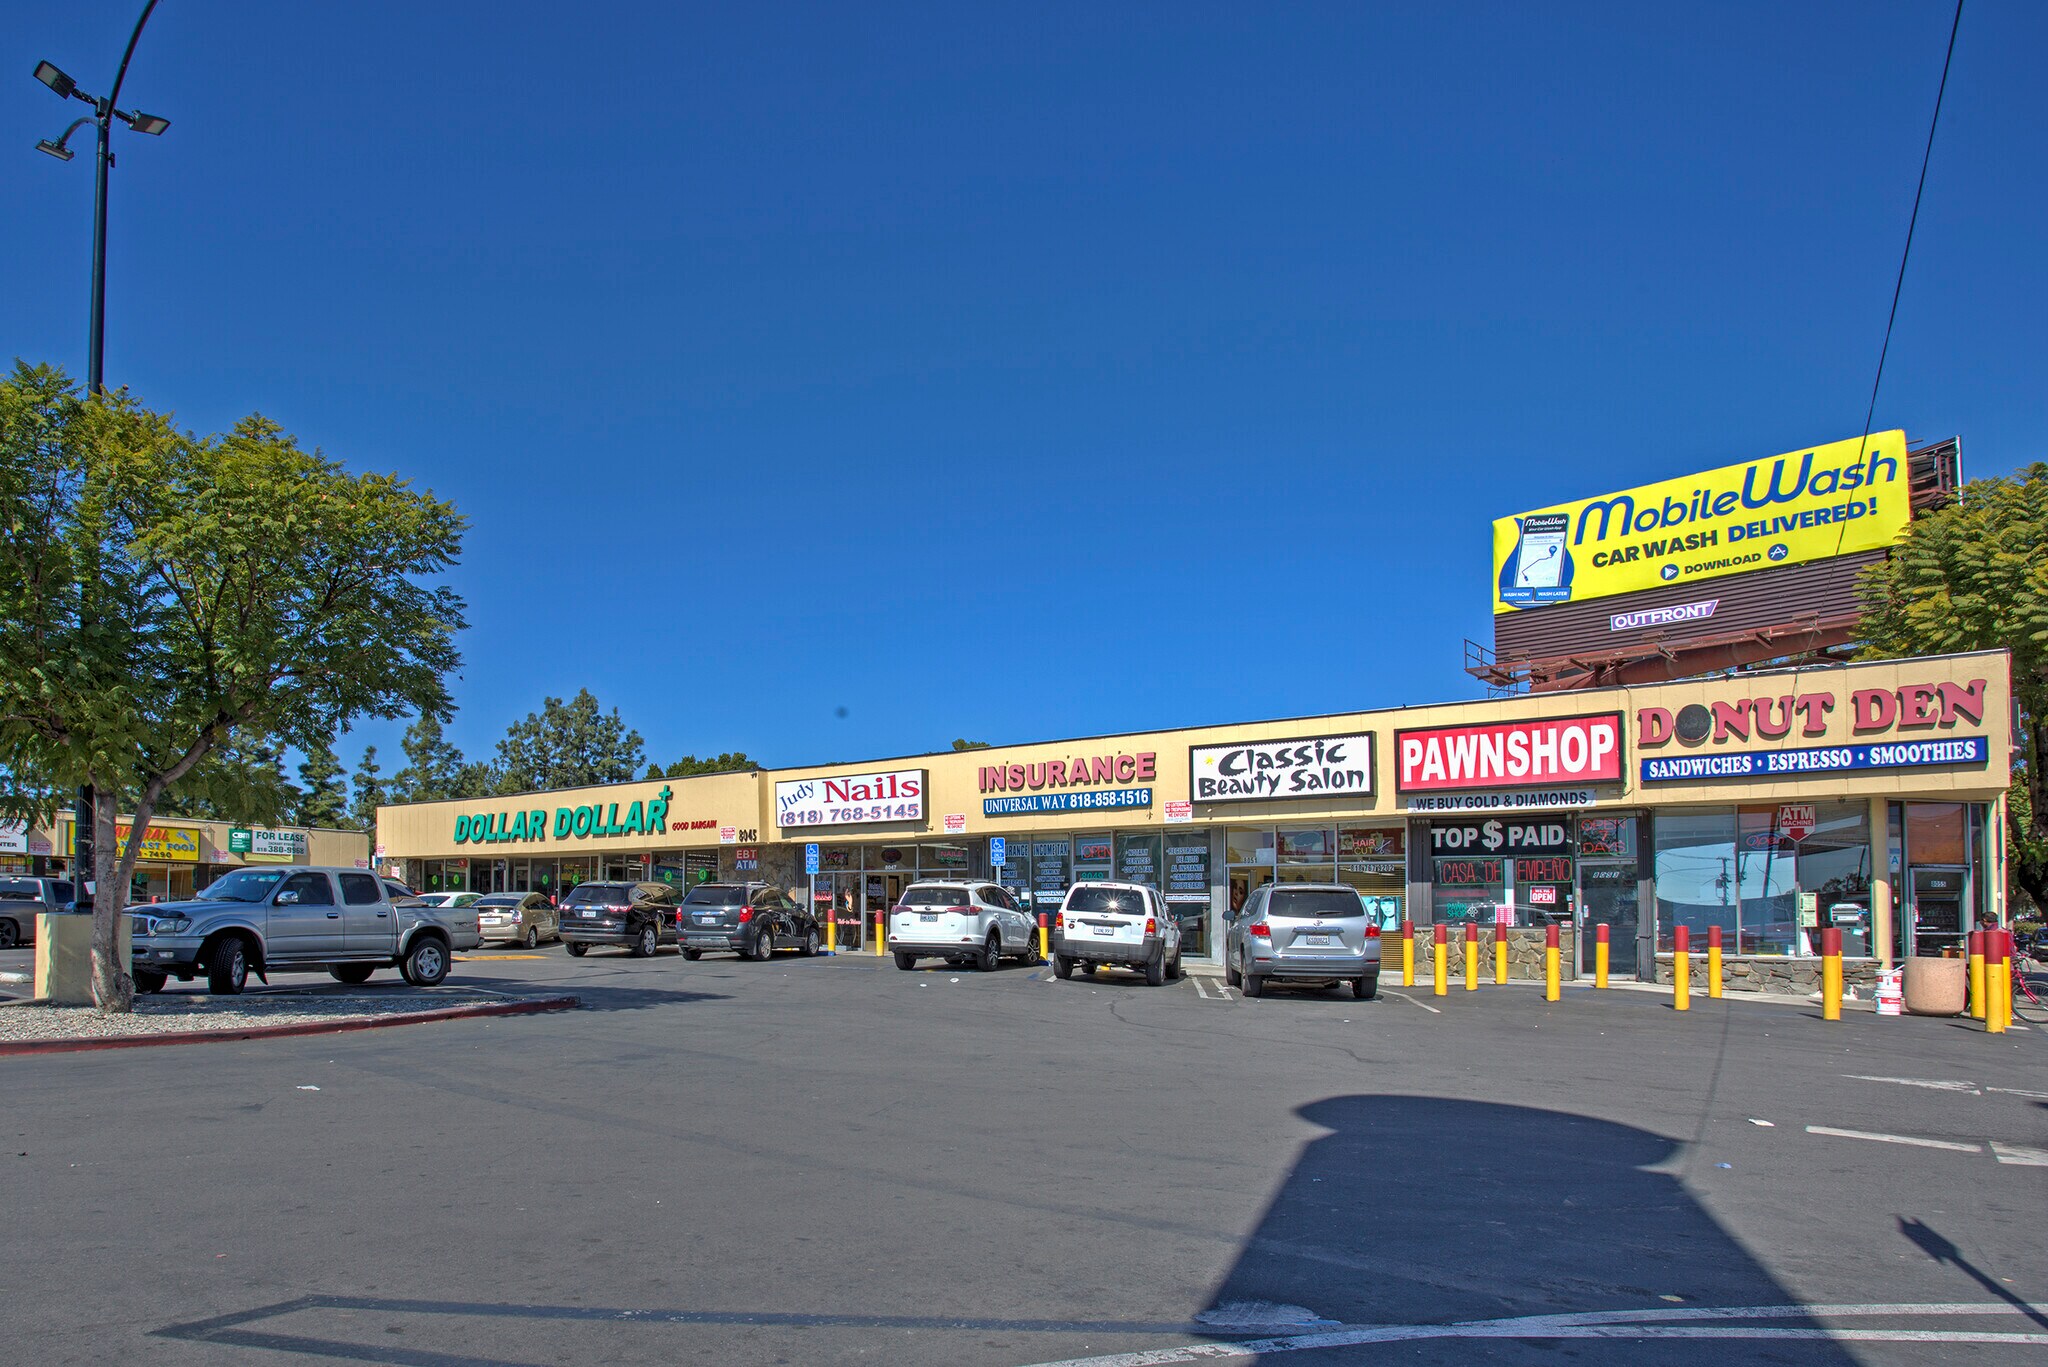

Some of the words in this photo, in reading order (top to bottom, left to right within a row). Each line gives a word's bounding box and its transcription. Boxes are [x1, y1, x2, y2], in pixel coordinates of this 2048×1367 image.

[1573, 451, 1898, 546] MobileWash
[1592, 544, 1640, 569] CAR
[1643, 530, 1718, 559] WASH
[1727, 497, 1878, 543] DELIVERED!
[1683, 552, 1762, 576] DOWNLOAD
[1614, 604, 1716, 630] OUTFRONT
[1852, 679, 1988, 733] DEN
[1218, 739, 1348, 777] Classic
[1402, 723, 1616, 783] PAWNSHOP
[1649, 755, 1752, 779] SANDWICHES
[1768, 748, 1852, 772] ESPRESSO
[1869, 741, 1977, 766] SMOOTHIES
[978, 752, 1157, 791] INSURANCE
[1198, 771, 1281, 798] Beauty
[1290, 769, 1365, 792] Salon
[778, 782, 815, 812] Judy
[823, 774, 920, 804] Nails
[985, 797, 1039, 814] UNIVERSAL
[1041, 795, 1068, 810] WAY
[1069, 788, 1149, 809] 818-858-1516
[1416, 797, 1435, 811] WE
[1436, 796, 1463, 810] BUY
[1464, 794, 1500, 809] GOLD
[1503, 794, 1513, 807] &
[1513, 792, 1588, 807] DIAMONDS
[779, 807, 824, 828] (818)
[829, 803, 919, 823] 768-5145
[1782, 805, 1814, 820] ATM
[453, 810, 547, 843] DOLLAR
[672, 822, 688, 831] GOOD
[691, 820, 717, 830] BARGAIN
[1782, 819, 1813, 827] MACHINE
[256, 831, 275, 840] FOR
[278, 833, 305, 842] LEASE
[738, 829, 757, 842] 8045
[1352, 838, 1377, 847] HAIR
[1431, 827, 1478, 848] TOP
[1481, 820, 1504, 851] $
[1508, 824, 1565, 847] PAID
[1745, 833, 1785, 849] Open
[167, 843, 195, 851] FOOD
[736, 849, 757, 859] EBT
[1033, 843, 1056, 856] INCOME
[1057, 843, 1069, 856] TAX
[1083, 845, 1112, 859] OPEN
[1354, 847, 1374, 855] CUT
[1583, 842, 1626, 854] DAYS
[736, 860, 757, 869] ATM
[1891, 856, 1899, 865] A
[1081, 871, 1104, 880] 8049
[1443, 863, 1477, 883] CASA
[1532, 892, 1553, 902] OPEN
